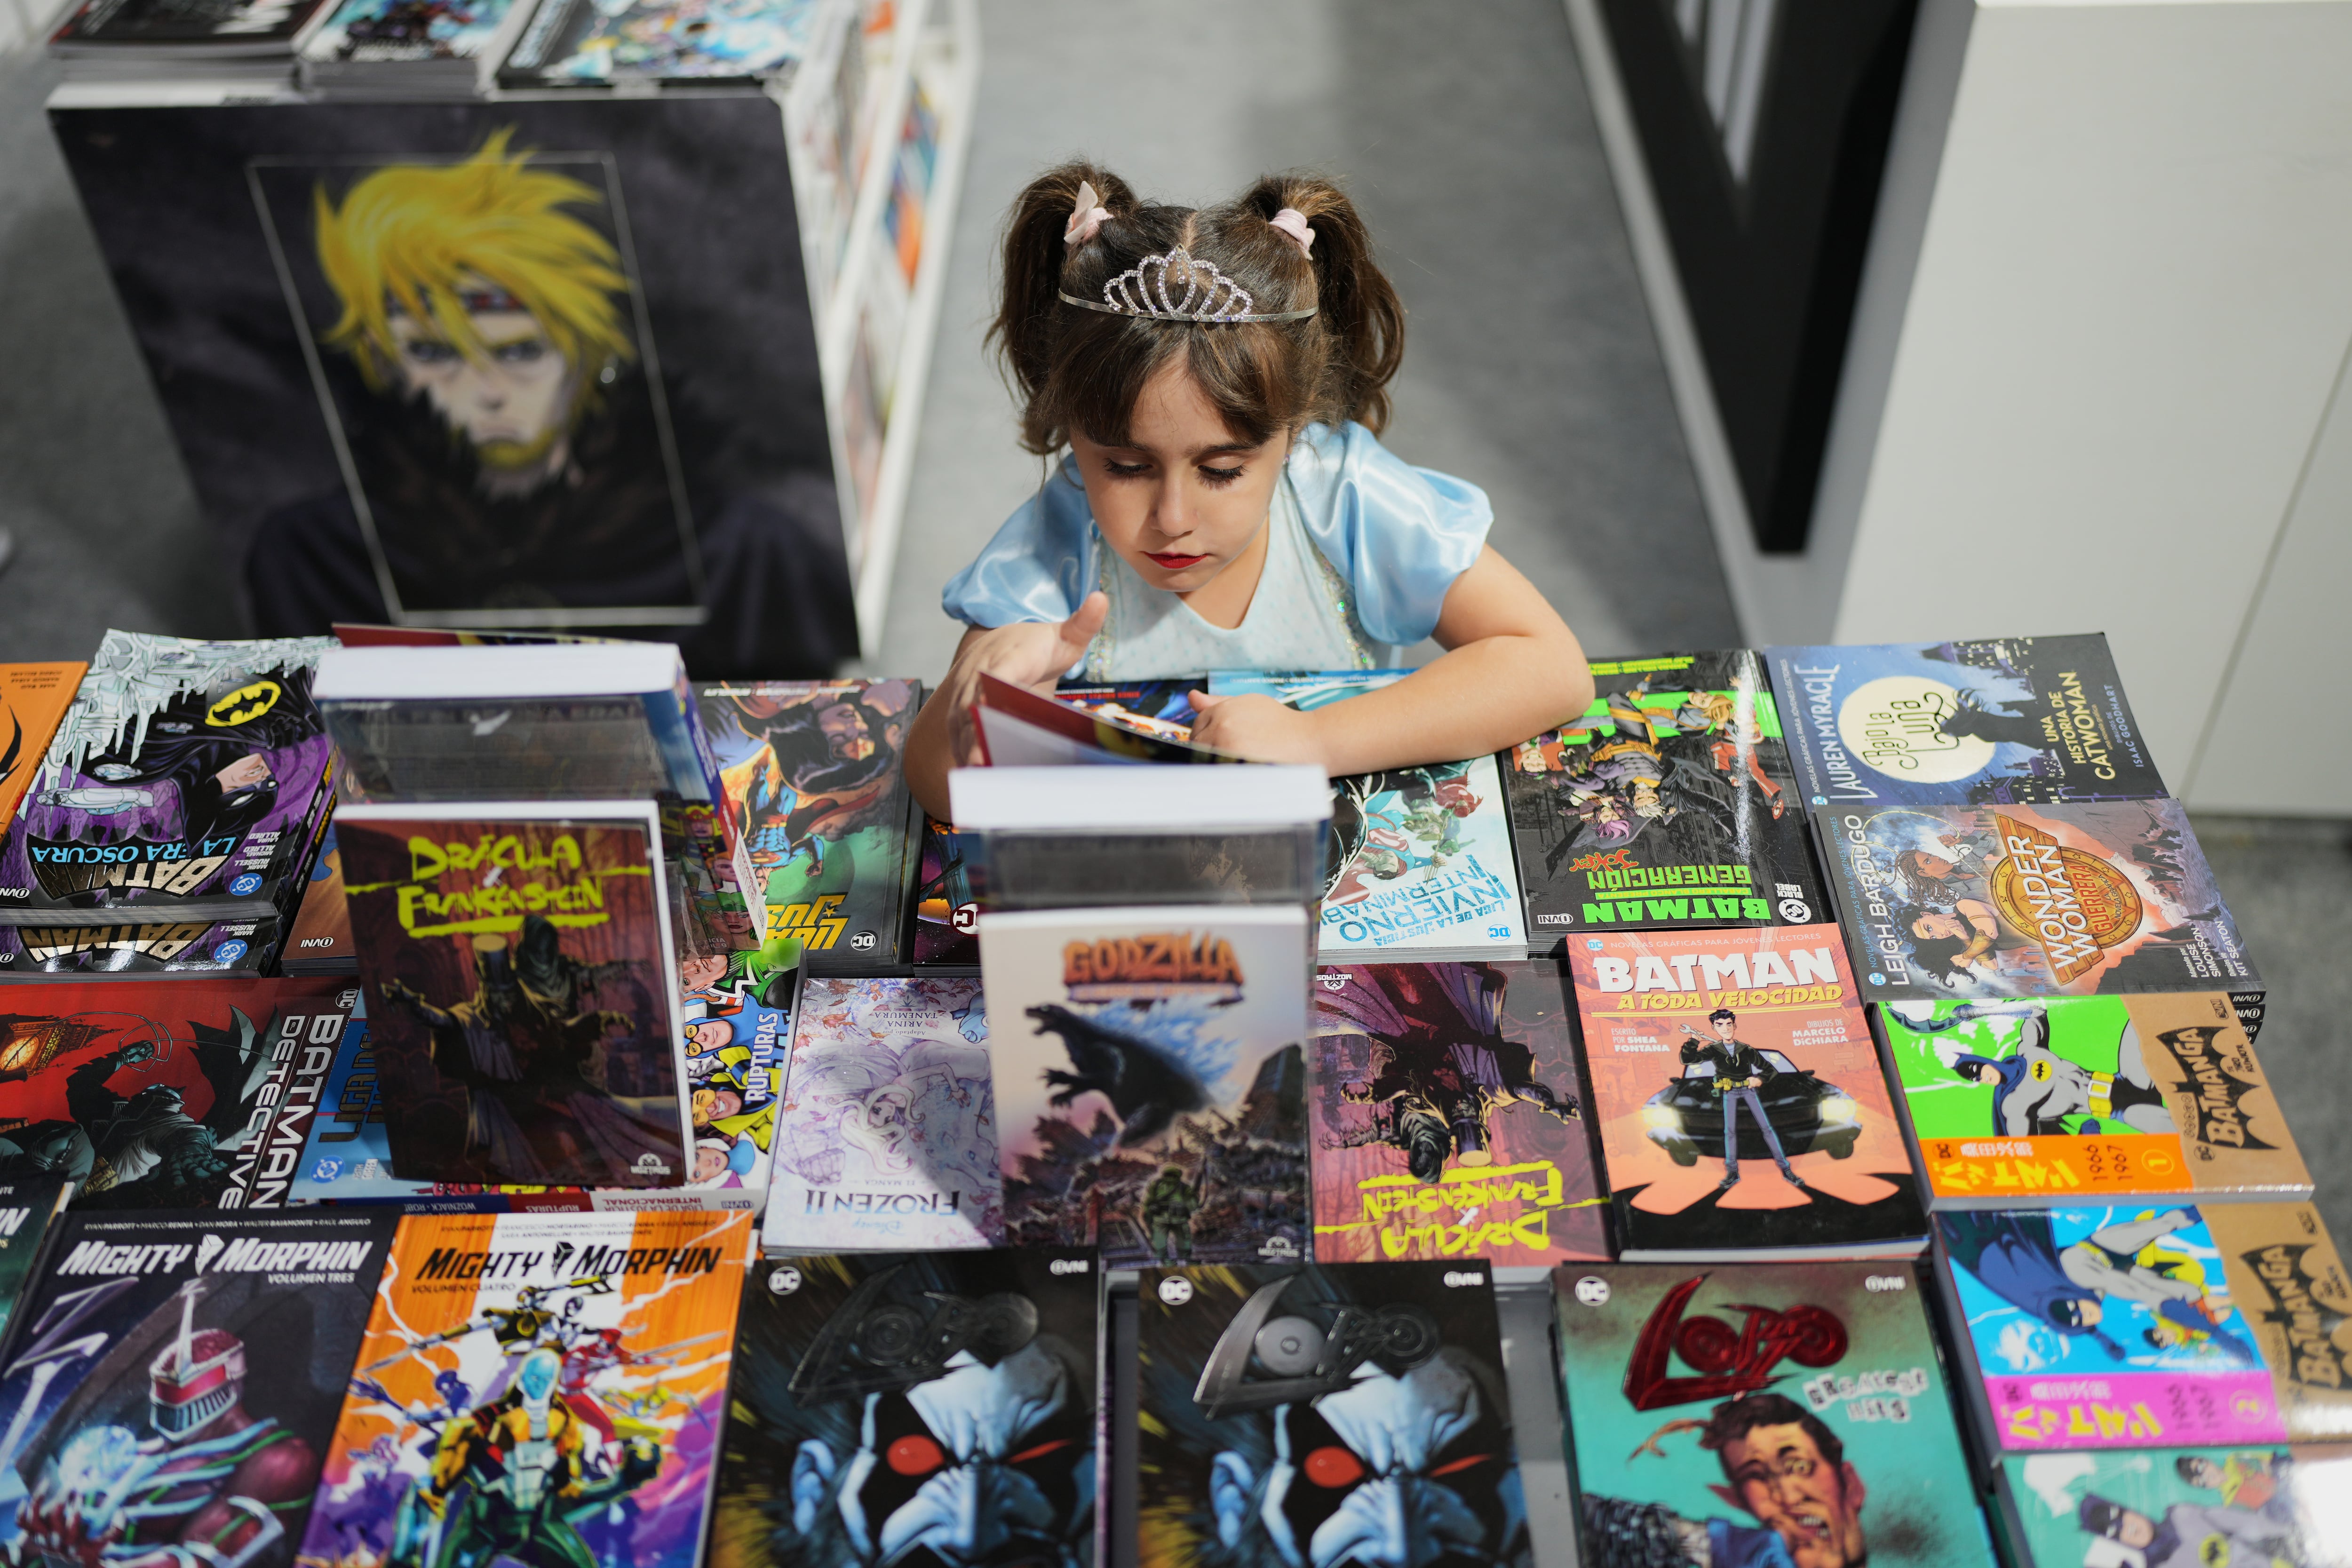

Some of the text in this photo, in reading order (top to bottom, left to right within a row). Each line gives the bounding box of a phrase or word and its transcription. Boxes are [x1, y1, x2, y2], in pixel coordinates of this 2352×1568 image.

[1794, 663, 1878, 800] LAUREN MYRACLE
[2040, 715, 2059, 742] UNA
[2048, 691, 2087, 764] HISTORIA DE
[2058, 671, 2115, 780] CATWOMAN
[2104, 684, 2144, 767] ISAAC GOODHART
[1808, 765, 1820, 792] NOVELAS
[203, 836, 236, 856] LA
[244, 845, 276, 853] ALLRED
[248, 831, 281, 840] ALLRED
[32, 846, 139, 864] OSCURA
[235, 858, 270, 867] RUSSELL
[1568, 849, 1639, 873] Joker
[34, 854, 228, 895] BATMAN
[1587, 865, 1752, 892] GENERACIÓN
[1775, 883, 1801, 892] LABEL
[397, 878, 604, 931] FRANKENSTEIN
[1340, 870, 1511, 943] INVIERNO
[1597, 891, 1649, 899] PRESENTA
[1777, 890, 1804, 899] BLACK
[1829, 816, 1884, 986] DC NOVELAS GRÁFICAS PARA JÓVENES LECTORES
[1844, 815, 1909, 986] LEIGH BARDUGO
[2007, 835, 2078, 970] WONDER
[2034, 844, 2098, 958] WOMAN
[2070, 865, 2114, 932] GUERRERA
[2114, 896, 2122, 919] NOVELA
[1374, 899, 1506, 947] LIGA DE LA JUSTICIA
[1538, 914, 1573, 925] OVNI
[1581, 898, 1772, 923] BATMAN
[220, 923, 257, 932] RUSSELL
[851, 935, 875, 947] DC
[1488, 926, 1510, 939] DC
[300, 936, 334, 948] OVNI
[1588, 939, 1604, 950] DC
[1611, 940, 1654, 948] NOVELAS
[1656, 938, 1703, 947] GRÁFICAS
[1732, 935, 1772, 945] JÓVENES
[1775, 933, 1822, 942] LECTORES
[2191, 927, 2221, 978] SIMONSON
[2215, 921, 2249, 977] KIT SEATON
[1064, 931, 1243, 983] GODZILLA
[1593, 947, 1839, 993] BATMAN
[2179, 947, 2198, 978] Adaptado por
[2186, 943, 2210, 978] LOUISE
[2224, 959, 2237, 977] Dibujos
[337, 989, 359, 1008] DC
[1617, 984, 1843, 1010] A TODA VELOCIDAD
[1807, 1020, 1834, 1028] DIBUJOS
[2234, 1008, 2260, 1019] OVN
[1627, 1035, 1657, 1044] SHEA
[1792, 1027, 1846, 1038] MARCELO
[745, 1012, 779, 1102] RUPTURAS
[1614, 1044, 1671, 1053] FONTANA
[2174, 1029, 2245, 1148] BATMANGA
[219, 1015, 306, 1210] DETECTIVE
[248, 1014, 345, 1209] BATMAN
[319, 1073, 375, 1143] LIGA
[2082, 1144, 2108, 1182] 1966
[2106, 1144, 2134, 1182] 1967
[602, 1197, 702, 1206] INTERNACIONAL
[804, 1190, 961, 1216] FROZEN II
[1362, 1166, 1563, 1222] FRANKENSTEIN
[525, 1203, 580, 1213] RUPTURAS
[57, 1238, 373, 1274] MIGHTY MORPHIN
[415, 1244, 723, 1280] MIGHTY MORPHIN
[268, 1272, 355, 1284] VOLUMEN TRES
[770, 1270, 800, 1292] DC
[1160, 1279, 1192, 1302] DC
[1576, 1280, 1609, 1303] DC
[2258, 1245, 2339, 1388] BATMANGA
[1622, 1271, 1848, 1411] LOBO
